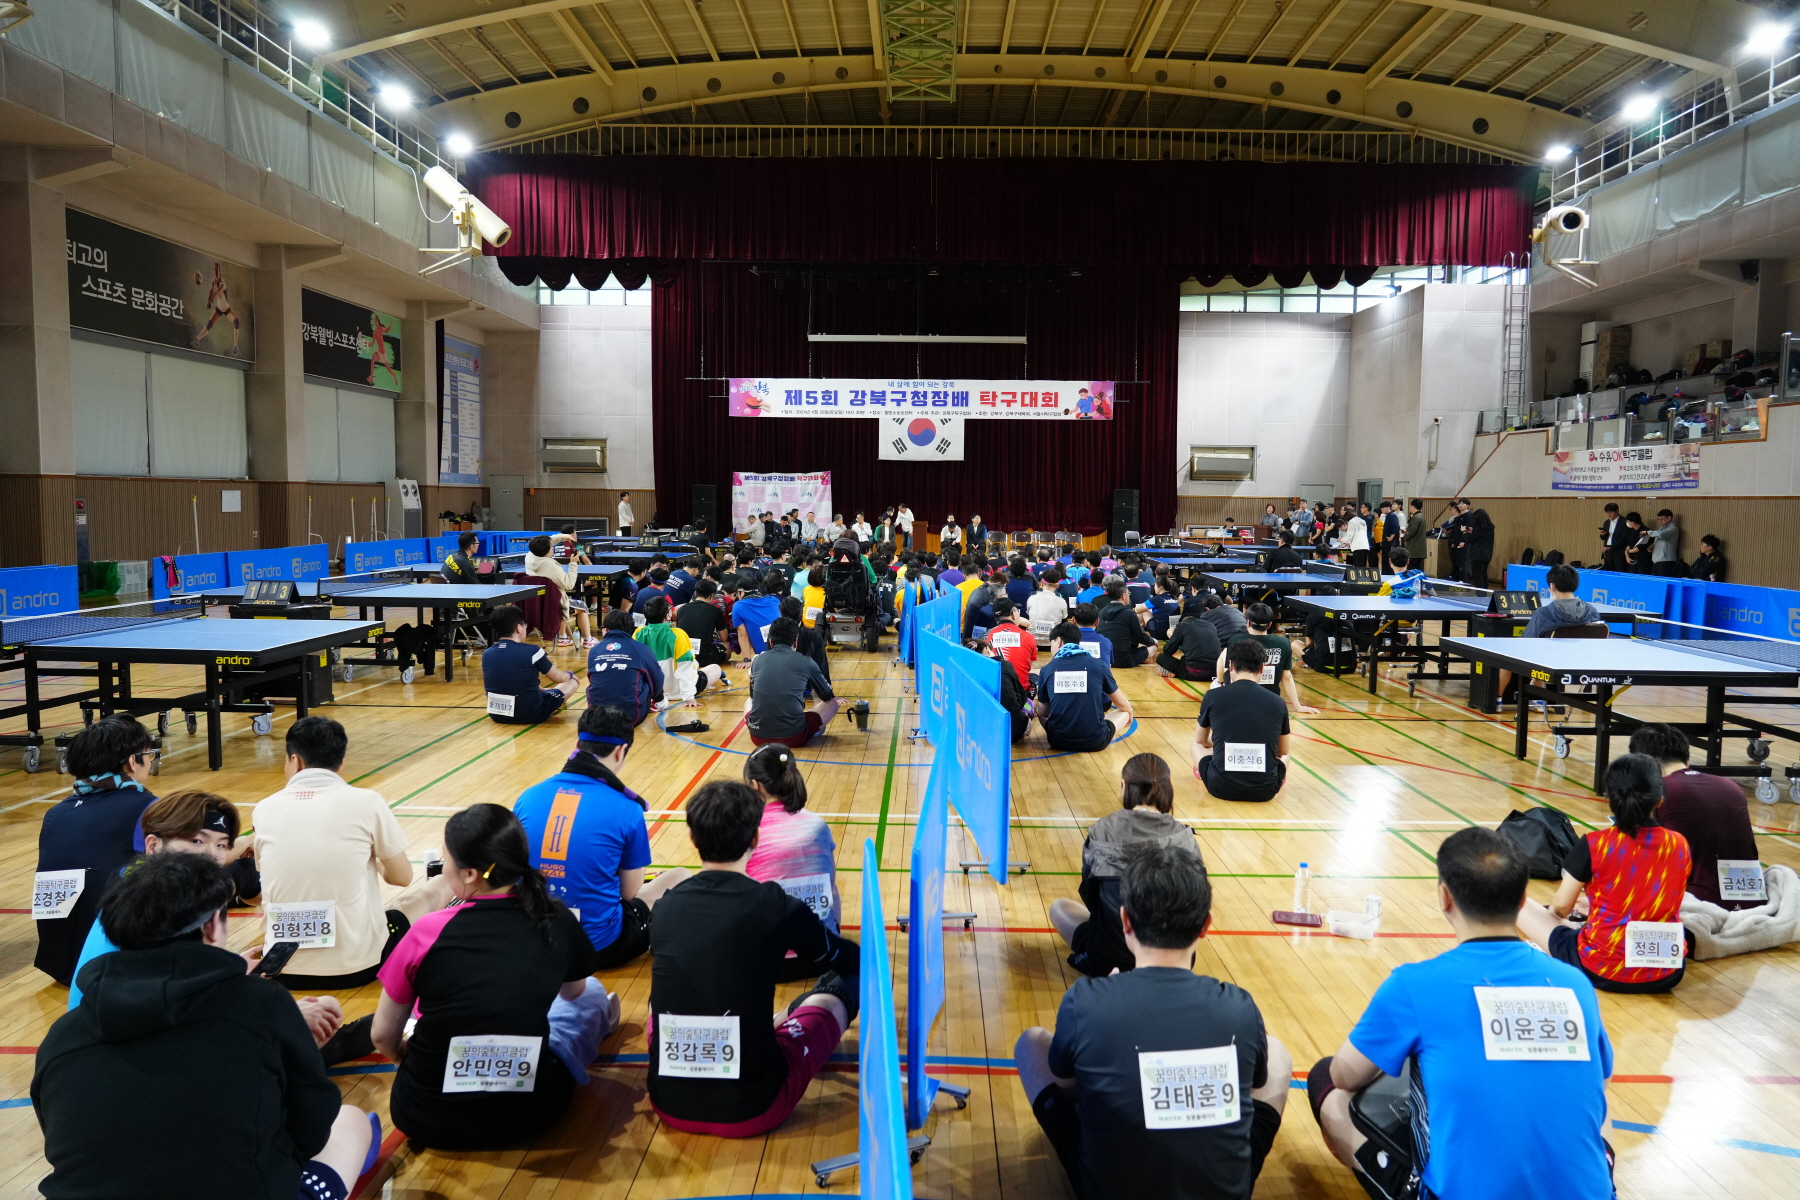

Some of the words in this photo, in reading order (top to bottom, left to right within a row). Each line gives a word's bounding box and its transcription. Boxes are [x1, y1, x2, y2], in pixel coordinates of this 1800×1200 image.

[81, 274, 127, 305] 스포츠
[131, 286, 184, 320] 문화공간
[302, 322, 370, 354] 강북웰빙스포츠센터
[887, 380, 895, 388] 내
[896, 380, 911, 388] 삶에
[912, 380, 925, 388] 힘이
[784, 389, 839, 406] 제5회
[849, 390, 969, 408] 강북구청장배
[979, 391, 1059, 408] 탁구대회
[1599, 448, 1653, 462] 수유OK탁구클럽
[364, 555, 383, 566] andro
[405, 551, 424, 561] andro
[256, 566, 281, 579] andro
[302, 559, 321, 573] andro
[186, 572, 217, 587] andro
[1350, 570, 1356, 580] 0
[1372, 571, 1378, 580] 0
[250, 586, 257, 598] 1
[279, 585, 288, 599] 3
[12, 591, 59, 610] andro
[1500, 595, 1508, 608] 3
[1511, 594, 1516, 603] 1
[1520, 594, 1525, 603] 1
[1531, 596, 1538, 608] 1
[1720, 606, 1763, 624] andro
[368, 628, 383, 638] andro
[216, 656, 251, 666] andro
[1531, 669, 1550, 682] andro
[966, 734, 992, 791] andro
[1256, 756, 1263, 765] 6
[540, 863, 566, 871] HUGO
[785, 884, 824, 897] 의숲탁구클럽
[1722, 877, 1757, 891] 금선호
[819, 895, 829, 909] 9
[276, 910, 326, 922] 꿈의숲탁구클럽
[272, 921, 317, 939] 임형진
[320, 921, 332, 935] 8
[1634, 941, 1660, 957] 정희
[1670, 944, 1680, 957] 9
[1493, 1000, 1569, 1015] 꿈의숲탁구클럽
[669, 1028, 729, 1041] 꿈의숲탁구클럽
[1490, 1017, 1560, 1041] 이윤호
[1563, 1019, 1579, 1041] 9
[461, 1046, 528, 1058] 꿈의숲탁구클럽
[665, 1041, 718, 1062] 정갑록
[721, 1044, 735, 1062] 9
[452, 1059, 513, 1078] 안민영
[517, 1061, 531, 1077] 9
[1155, 1064, 1228, 1083] 꿈의숲탁구클럽
[1150, 1083, 1218, 1110] 김태훈
[1221, 1082, 1235, 1104] 9
